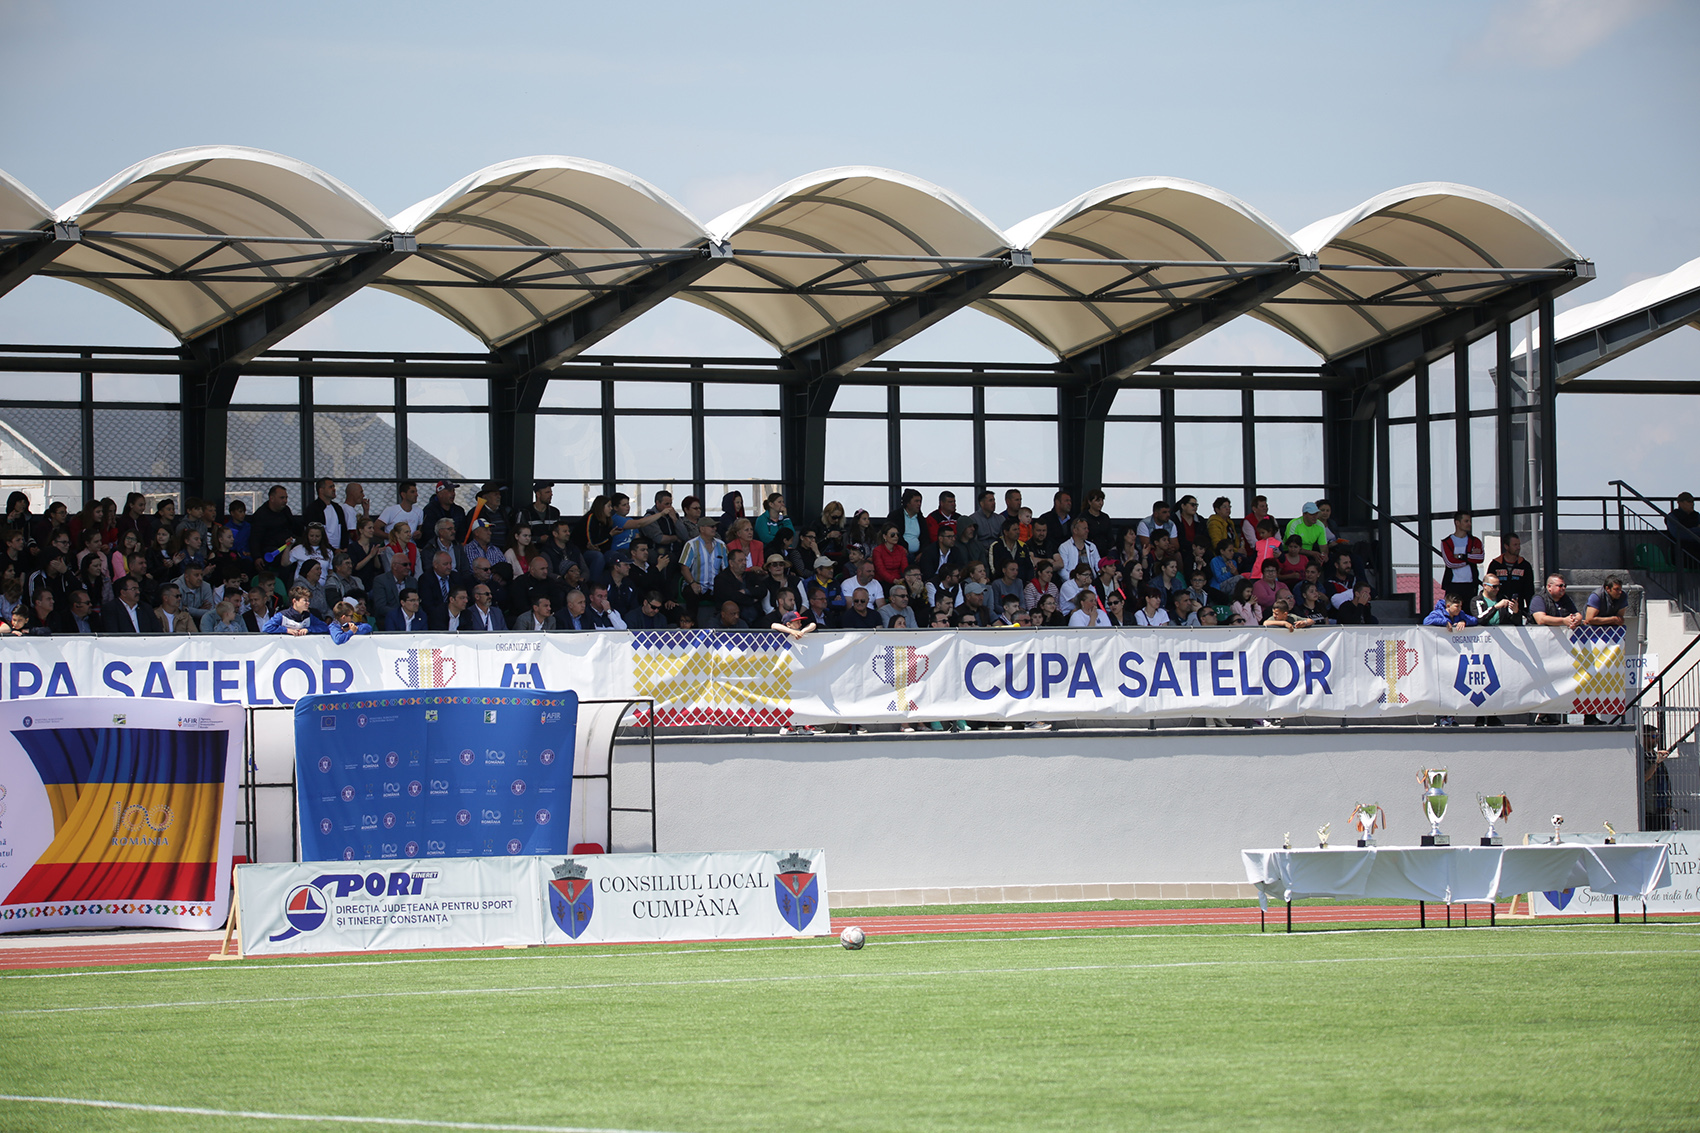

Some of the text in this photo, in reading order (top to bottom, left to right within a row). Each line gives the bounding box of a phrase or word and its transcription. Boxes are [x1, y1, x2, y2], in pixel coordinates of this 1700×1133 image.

[1452, 636, 1483, 644] ORGANIZAT
[496, 642, 541, 652] ORGANIZAT DE
[1626, 658, 1648, 668] CTOR
[963, 650, 1333, 700] CUPA SATELOR
[1468, 672, 1486, 685] FRF
[1629, 672, 1636, 685] 3
[0, 659, 354, 705] PA SATELOR
[112, 801, 174, 835] 100
[112, 834, 169, 846] ROMÂNIA
[600, 872, 769, 893] CONSILIUL LOCAL
[336, 900, 514, 916] DIRECȚIA JUDEȚEANĂ PENTRU SPORT
[632, 894, 740, 919] CUMPĂNA
[348, 916, 388, 925] TINERET
[390, 914, 448, 926] CONSTANȚA
